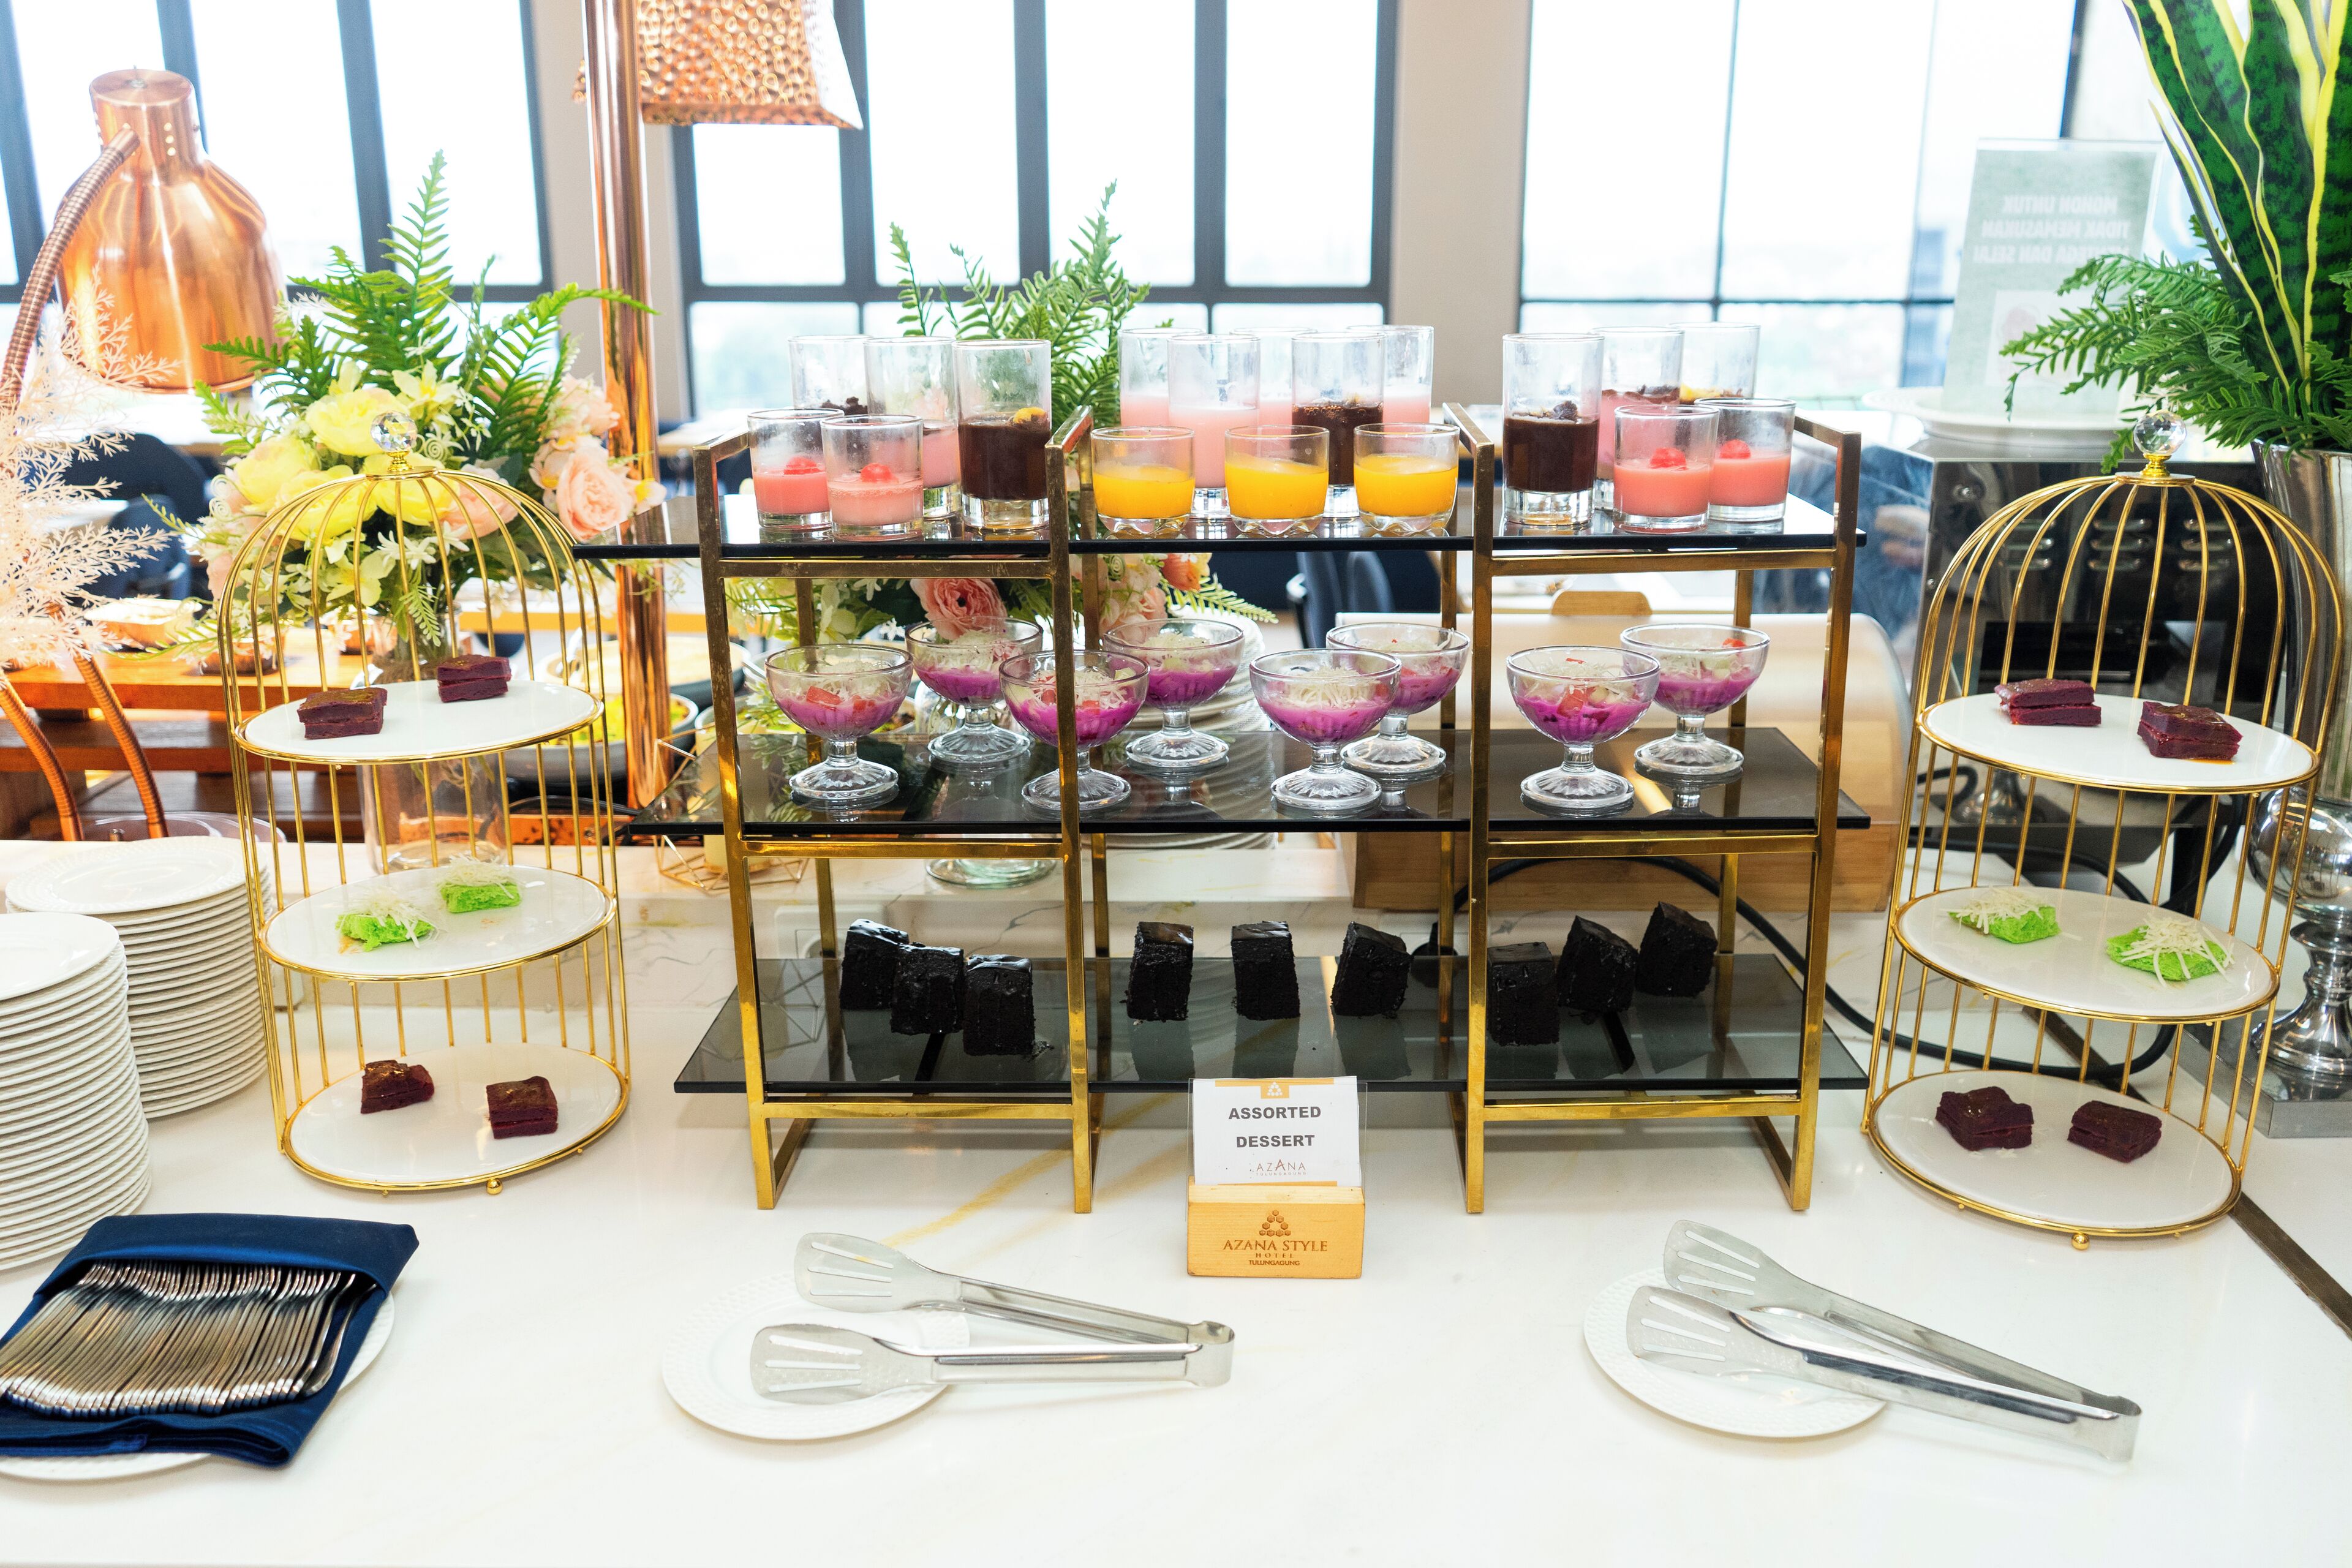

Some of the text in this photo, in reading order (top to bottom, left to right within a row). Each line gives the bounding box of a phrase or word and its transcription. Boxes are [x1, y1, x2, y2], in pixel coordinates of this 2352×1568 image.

[1228, 1106, 1321, 1120] ASSORTED
[1236, 1134, 1315, 1148] DESSERT
[1256, 1159, 1306, 1172] AZANA
[1223, 1239, 1328, 1251] AZANA STYLE
